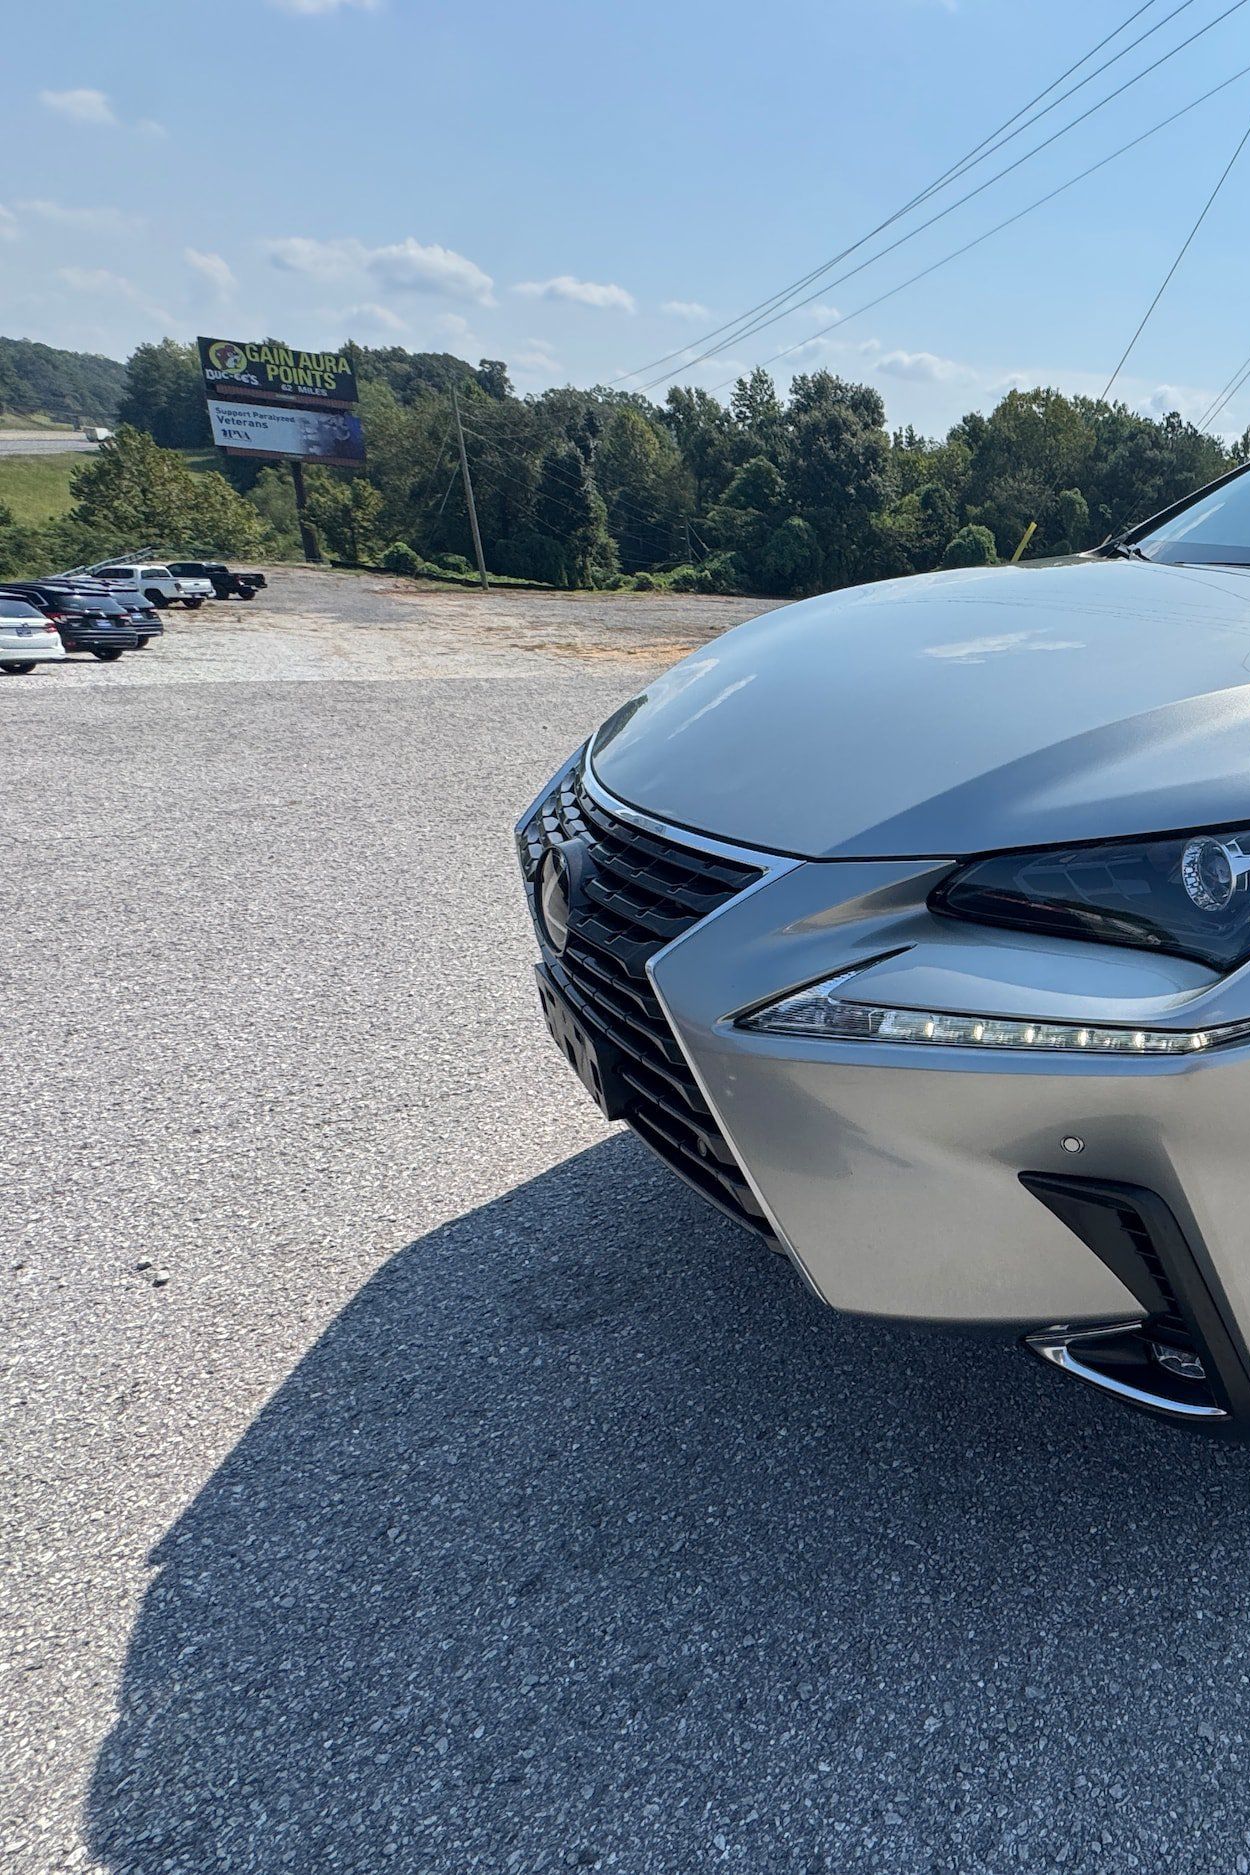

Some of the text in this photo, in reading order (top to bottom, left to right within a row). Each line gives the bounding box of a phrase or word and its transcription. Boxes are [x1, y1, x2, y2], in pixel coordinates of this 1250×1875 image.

[245, 344, 351, 375] GAIN AURA
[266, 364, 336, 390] POINTS
[281, 383, 328, 396] 62 MILES
[215, 407, 296, 424] Support Paralyzed
[216, 415, 269, 429] Veterans
